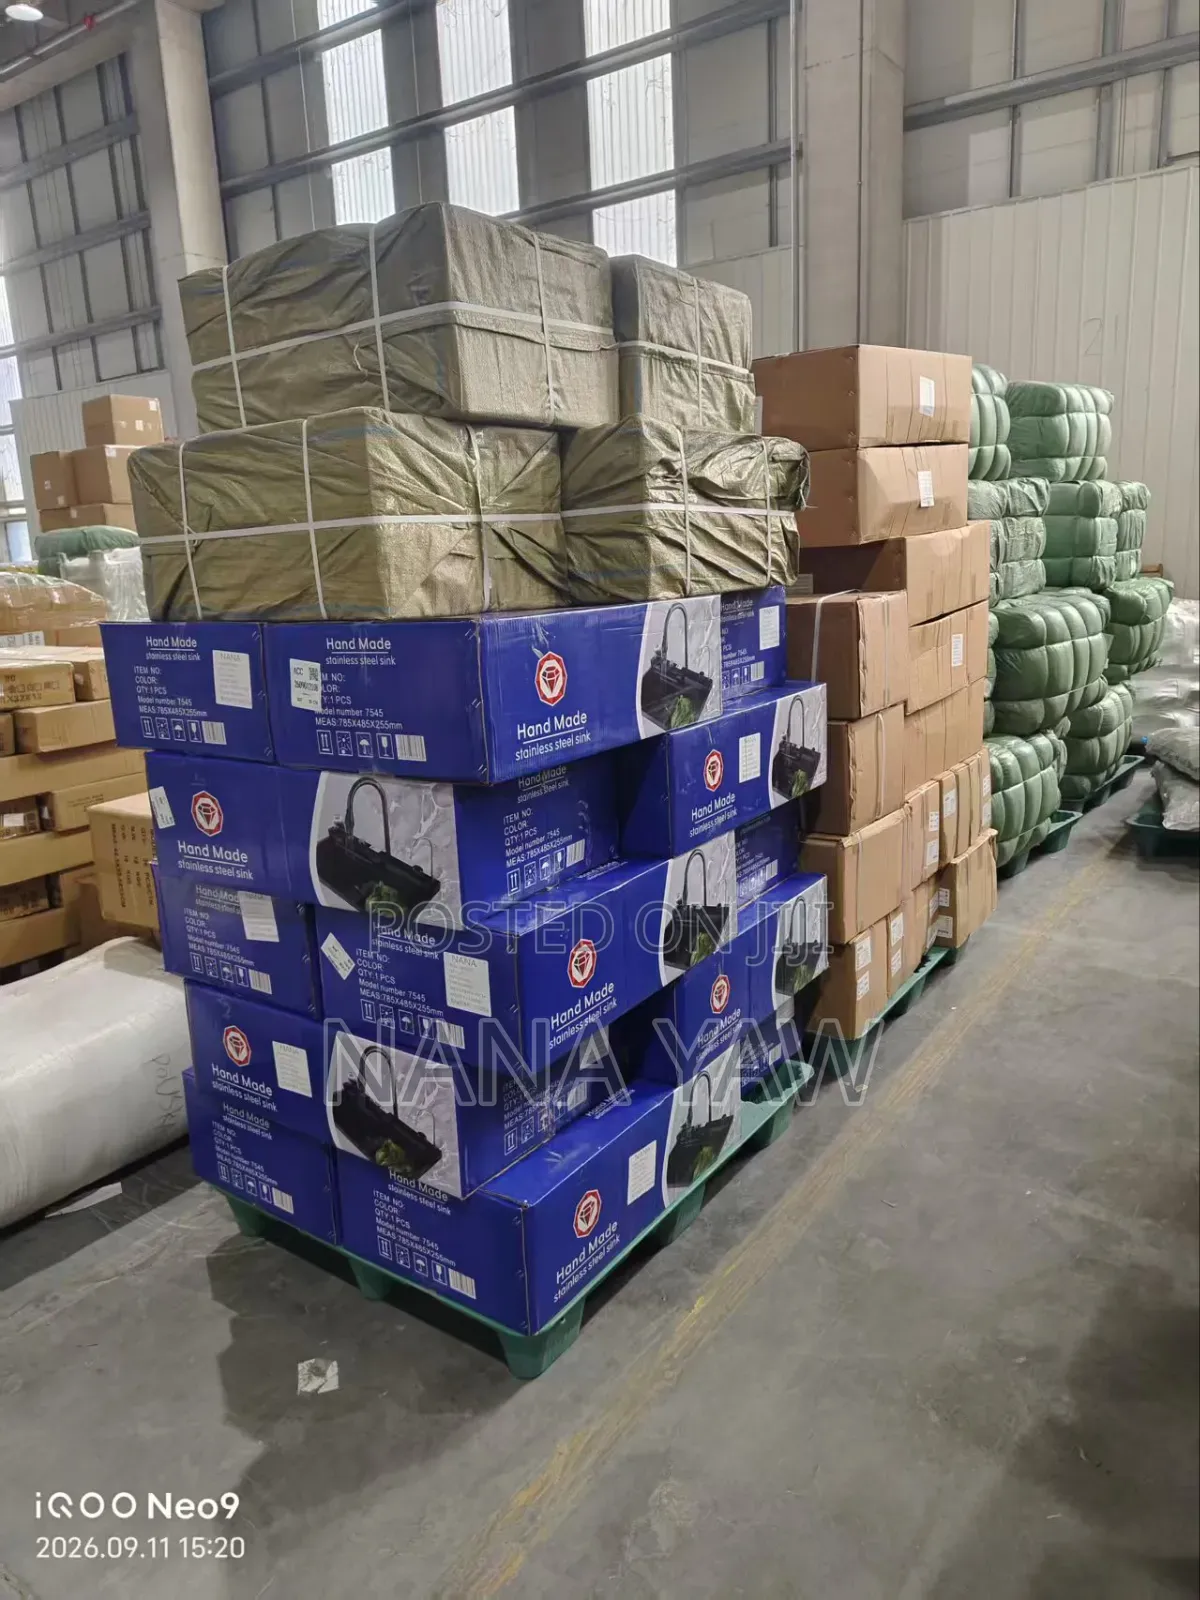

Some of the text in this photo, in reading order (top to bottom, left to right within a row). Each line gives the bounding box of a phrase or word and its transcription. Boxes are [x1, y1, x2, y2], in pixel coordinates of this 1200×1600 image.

[145, 636, 197, 648] Hand Made
[326, 638, 391, 650] Hand Made
[146, 652, 200, 661] stainless steel sink
[325, 656, 396, 665] stainless steel sink
[134, 665, 148, 674] ITEM
[331, 673, 346, 682] NO:
[138, 695, 154, 705] Model
[155, 697, 175, 705] number
[154, 687, 167, 695] PCS
[336, 696, 352, 705] PCS
[336, 708, 362, 717] number
[365, 708, 384, 718] 7545
[517, 710, 588, 740] Hand Made
[515, 731, 591, 761] stainless steel sink
[518, 765, 567, 789] Hand Made
[517, 780, 569, 804] stainless steel sink
[503, 811, 520, 825] ITEM
[691, 792, 736, 822] Hand Made
[524, 827, 538, 839] PCS
[689, 808, 738, 838] stainless steel sink
[177, 840, 210, 858] Hand
[213, 846, 248, 863] Made
[505, 827, 560, 857] Model number 7545
[178, 860, 254, 881] stainless steel sink
[195, 885, 219, 898] Hand
[373, 921, 436, 946] Hand Made
[356, 948, 374, 959] ITEM
[372, 938, 440, 961] stainless steel sink
[451, 955, 478, 968] NANA
[358, 978, 426, 1002] Model number 7545
[380, 973, 396, 984] PCS
[550, 982, 615, 1030] Hand Made
[549, 997, 618, 1050] stainless steel sink
[211, 1062, 273, 1097] Hand Made
[212, 1081, 278, 1112] stainless steel sink
[223, 1102, 270, 1129] Hand Made
[223, 1115, 273, 1141] stainless steel sink
[373, 1188, 390, 1202] ITEM
[389, 1169, 449, 1202] Hand Made
[388, 1183, 451, 1216] stainless steel sink
[376, 1216, 439, 1251] Model number 7545
[395, 1216, 411, 1230] PCS
[556, 1221, 618, 1284] Hand Made
[553, 1233, 621, 1303] stainless steel sink
